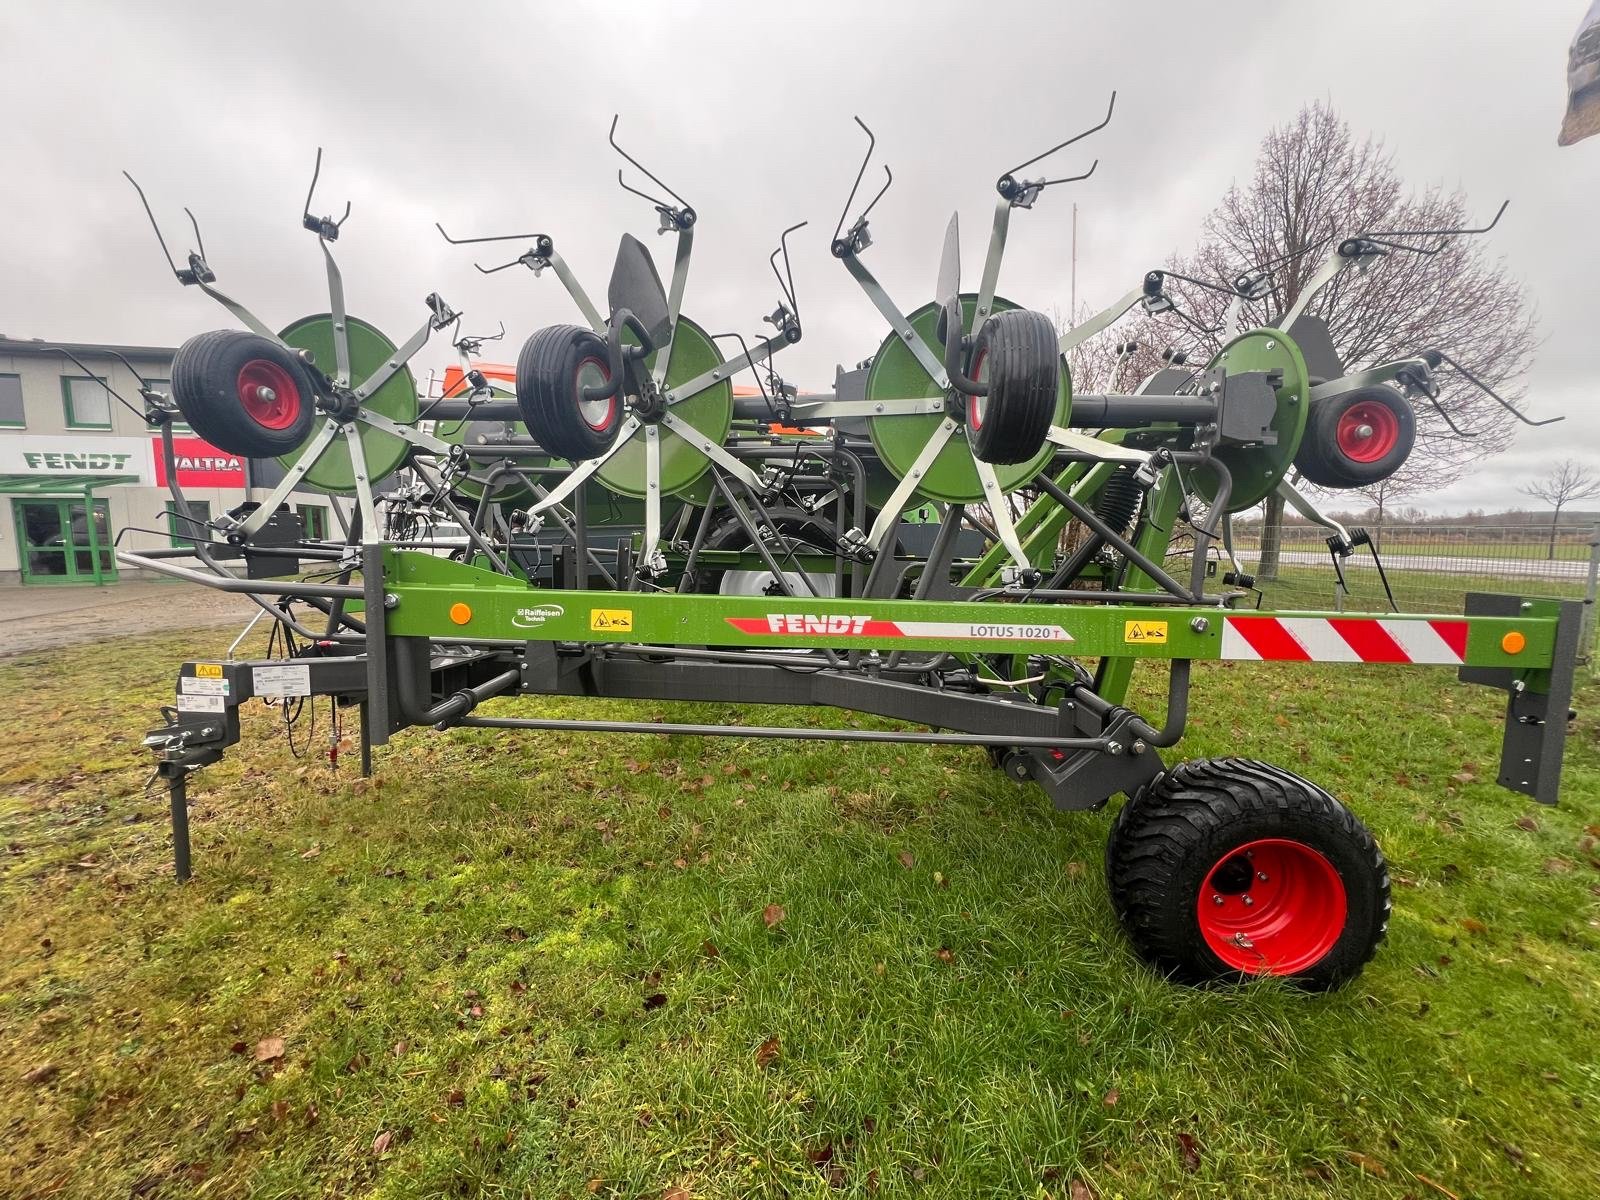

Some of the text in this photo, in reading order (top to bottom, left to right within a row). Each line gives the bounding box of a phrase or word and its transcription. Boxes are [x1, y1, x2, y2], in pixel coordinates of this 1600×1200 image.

[23, 452, 132, 470] FENDT
[524, 608, 561, 617] Raiffeisen
[766, 613, 872, 634] FENDT
[970, 625, 1060, 639] LOTUS 1020 T
